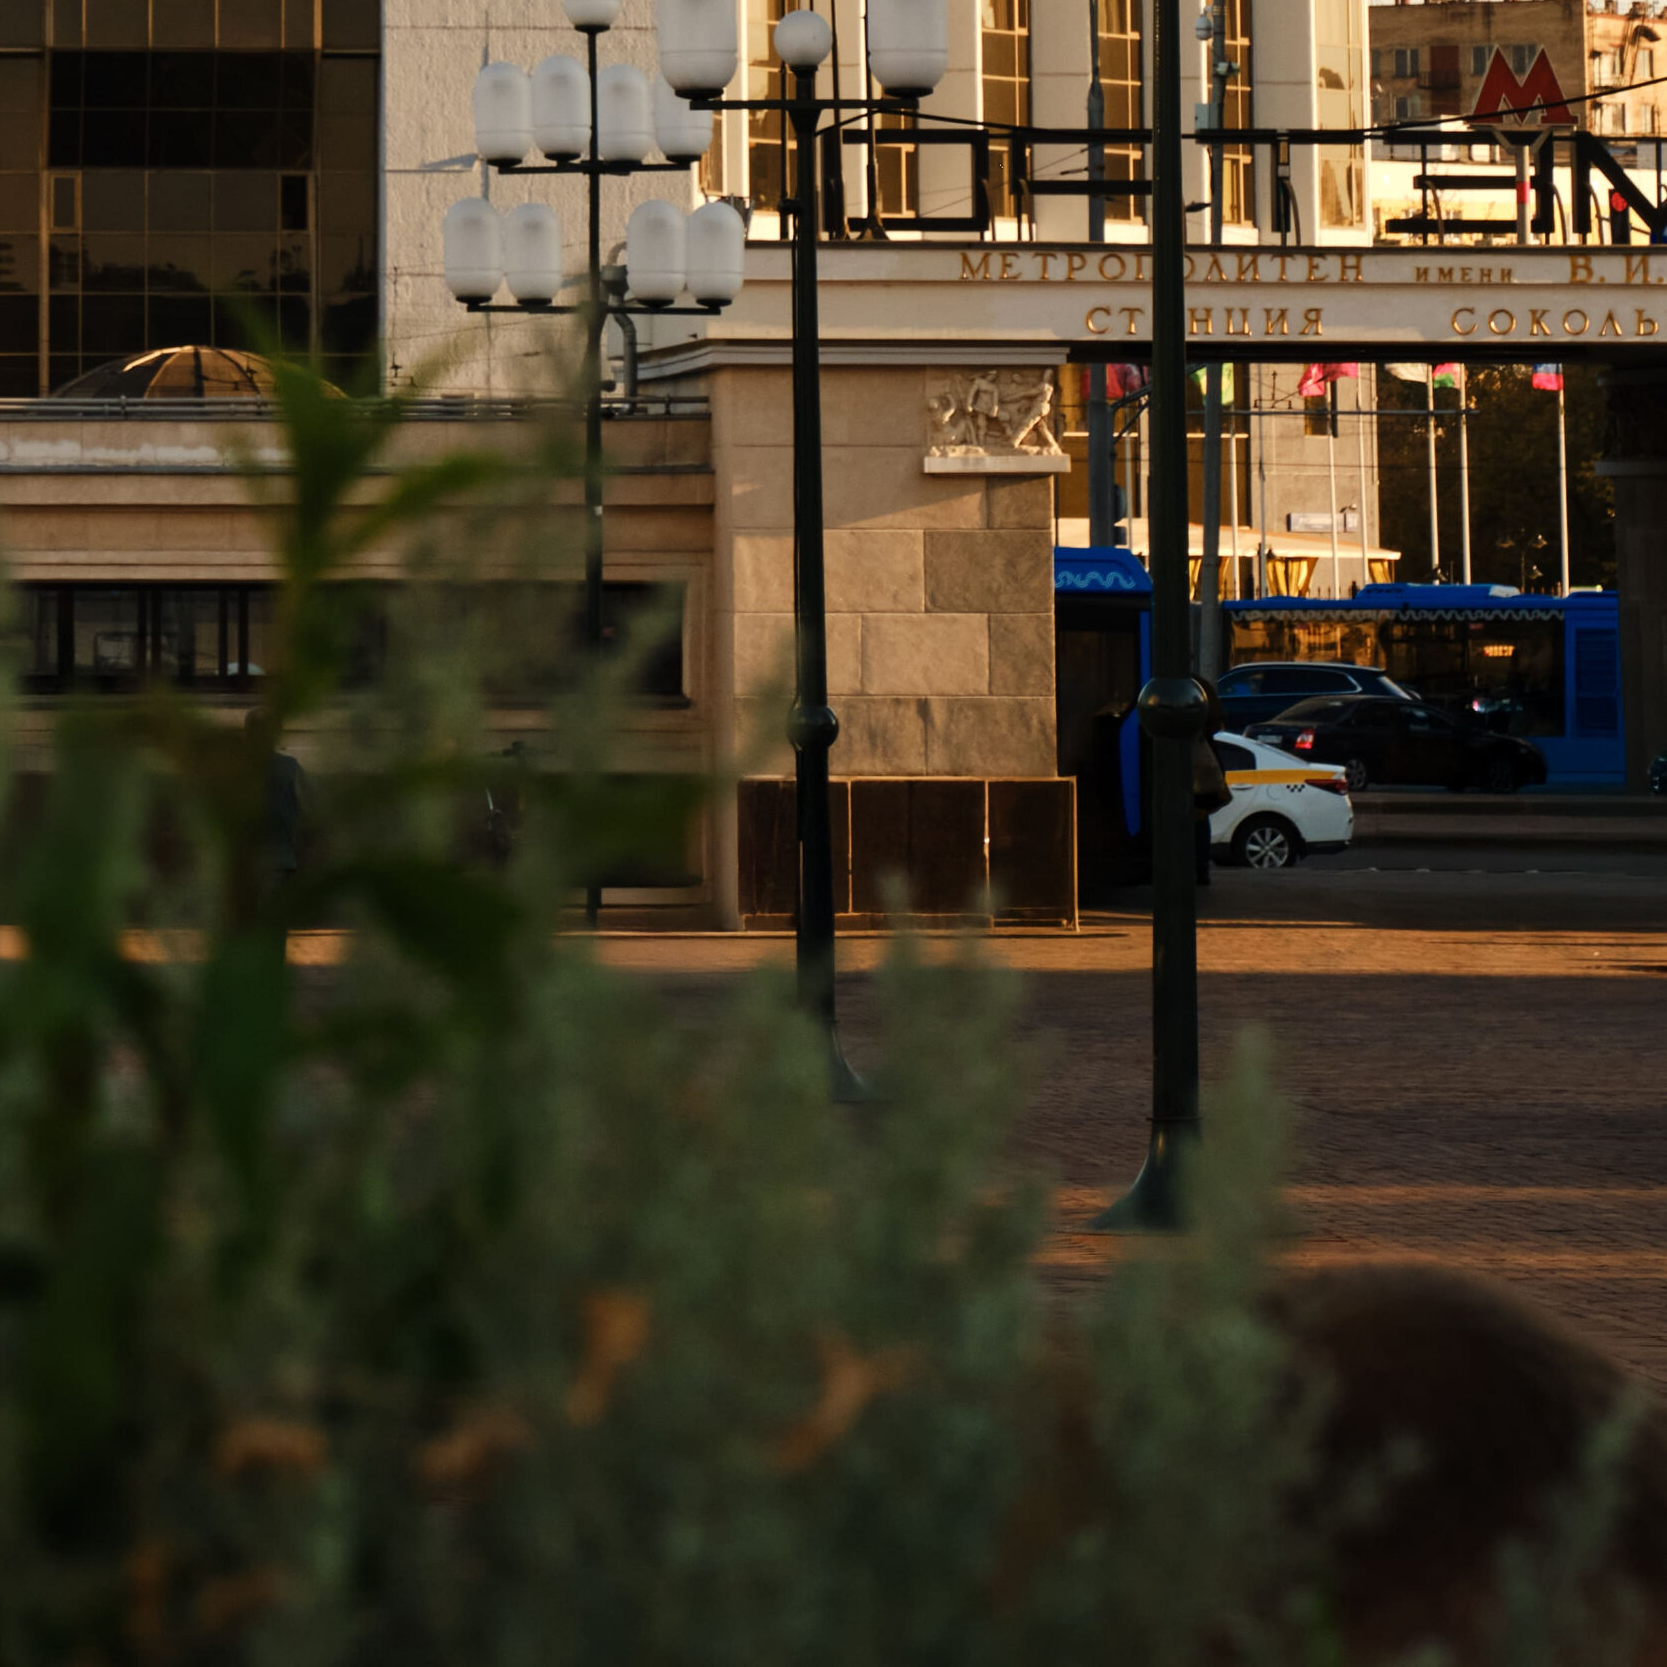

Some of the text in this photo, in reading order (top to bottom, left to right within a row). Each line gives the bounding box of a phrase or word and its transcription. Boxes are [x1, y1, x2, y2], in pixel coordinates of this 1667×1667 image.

[1415, 267, 1513, 283] ИМЕНИ
[1568, 253, 1606, 284] В.
[1085, 306, 1667, 336] СТНЦИЯ СОКОЛЬ
